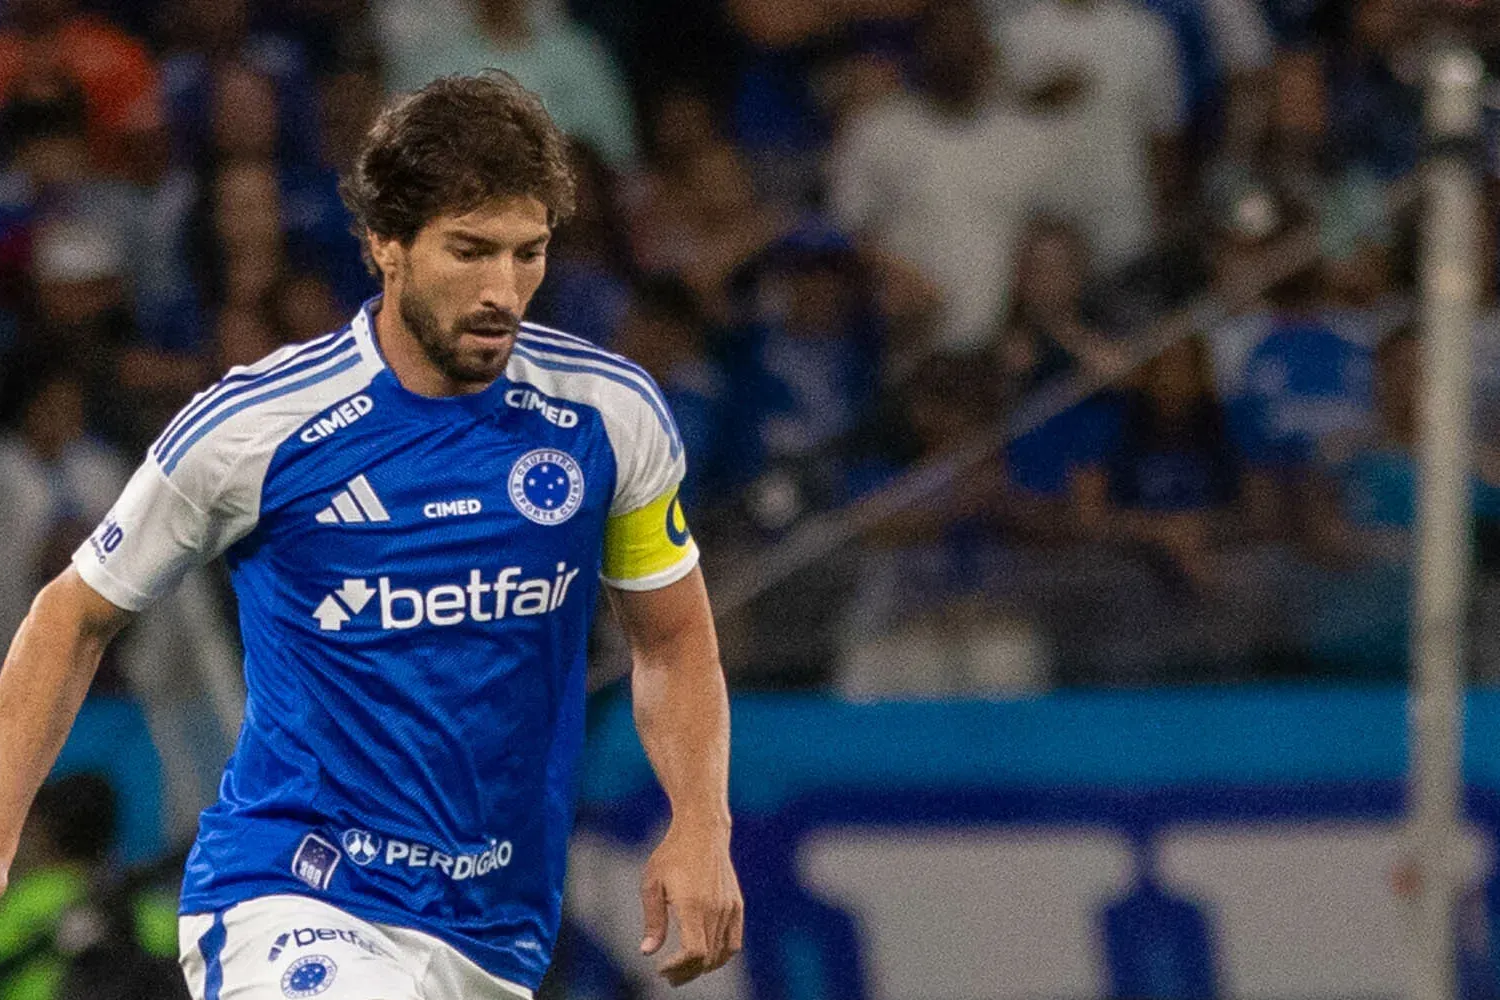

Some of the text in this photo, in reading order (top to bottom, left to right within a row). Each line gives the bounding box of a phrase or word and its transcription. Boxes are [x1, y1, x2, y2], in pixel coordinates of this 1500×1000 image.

[300, 394, 374, 443] CIMED
[504, 389, 579, 429] CIMED
[423, 499, 482, 519] CIMED
[379, 561, 579, 630] betfair
[386, 838, 512, 880] PERDIGÃO
